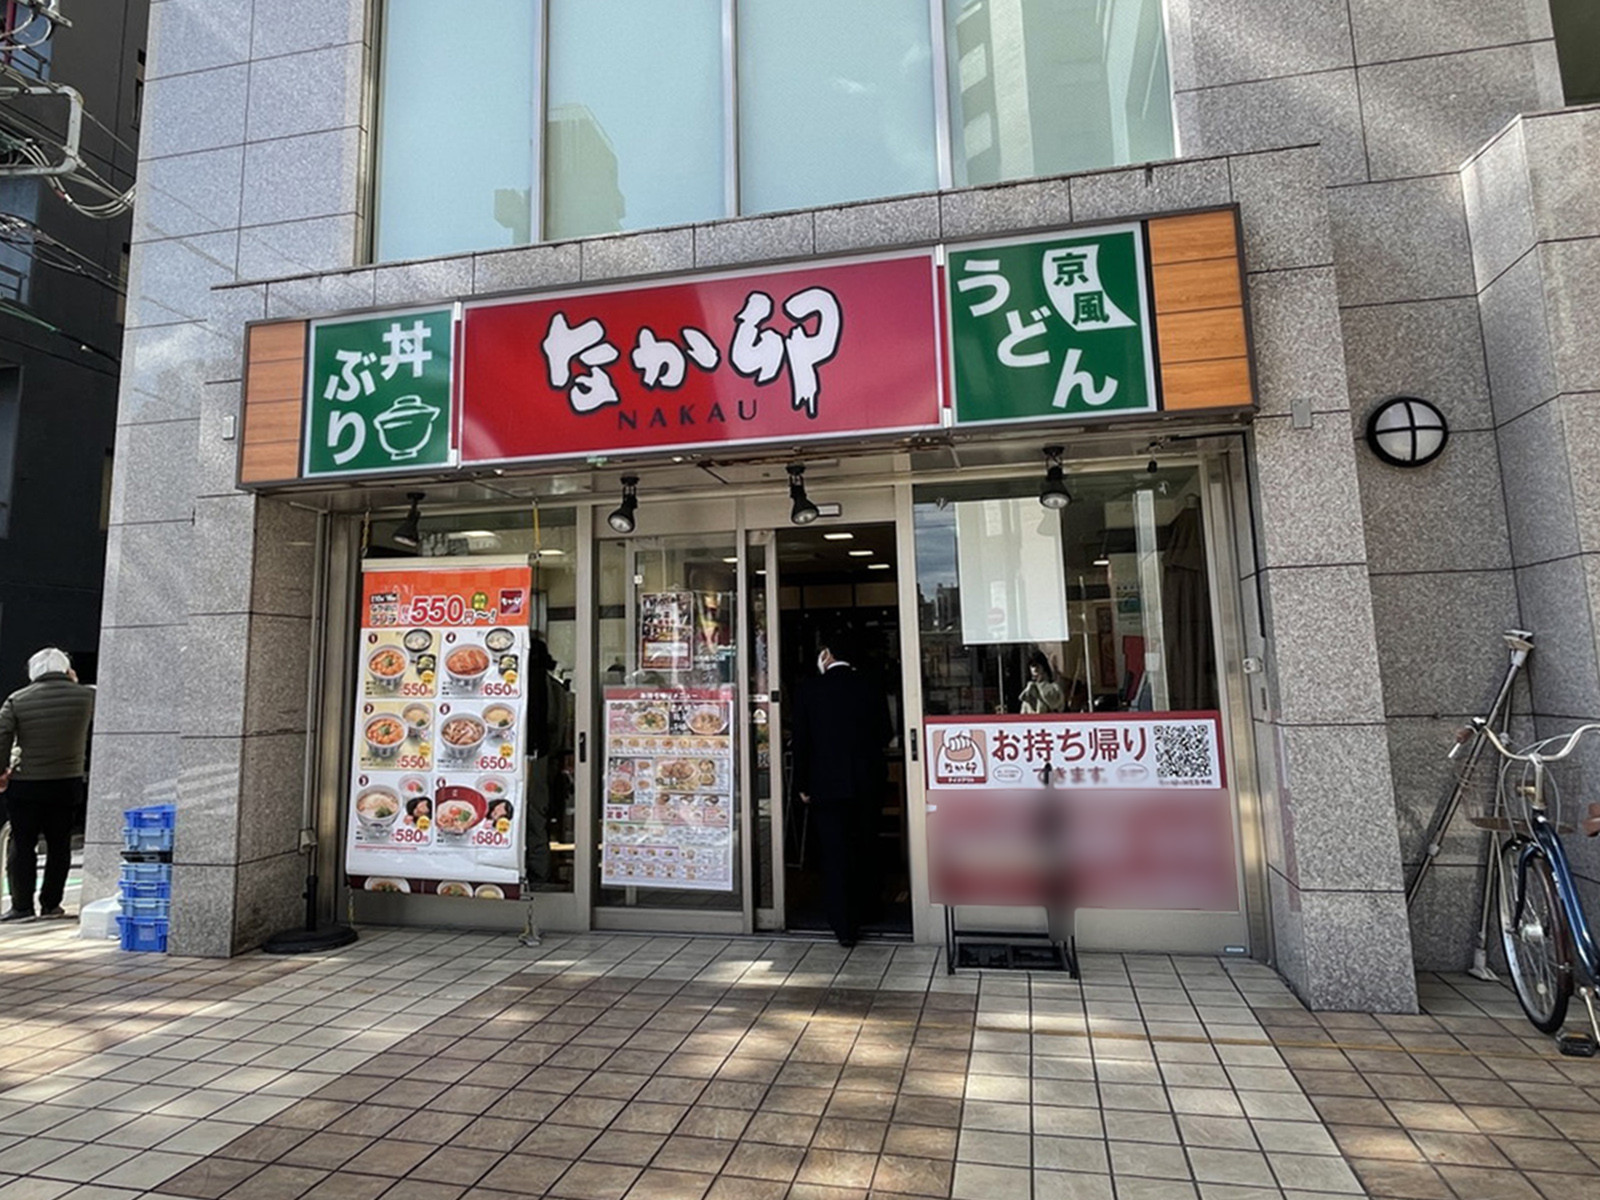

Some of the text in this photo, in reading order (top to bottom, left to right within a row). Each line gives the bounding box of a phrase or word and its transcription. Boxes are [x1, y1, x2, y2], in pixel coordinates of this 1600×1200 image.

[957, 259, 1118, 409] うどん
[1052, 252, 1110, 327] 京風
[323, 319, 433, 466] 丼ぶり
[541, 286, 842, 418] なか卯
[618, 399, 758, 430] NAKAU
[991, 727, 1147, 763] お持ち帰り
